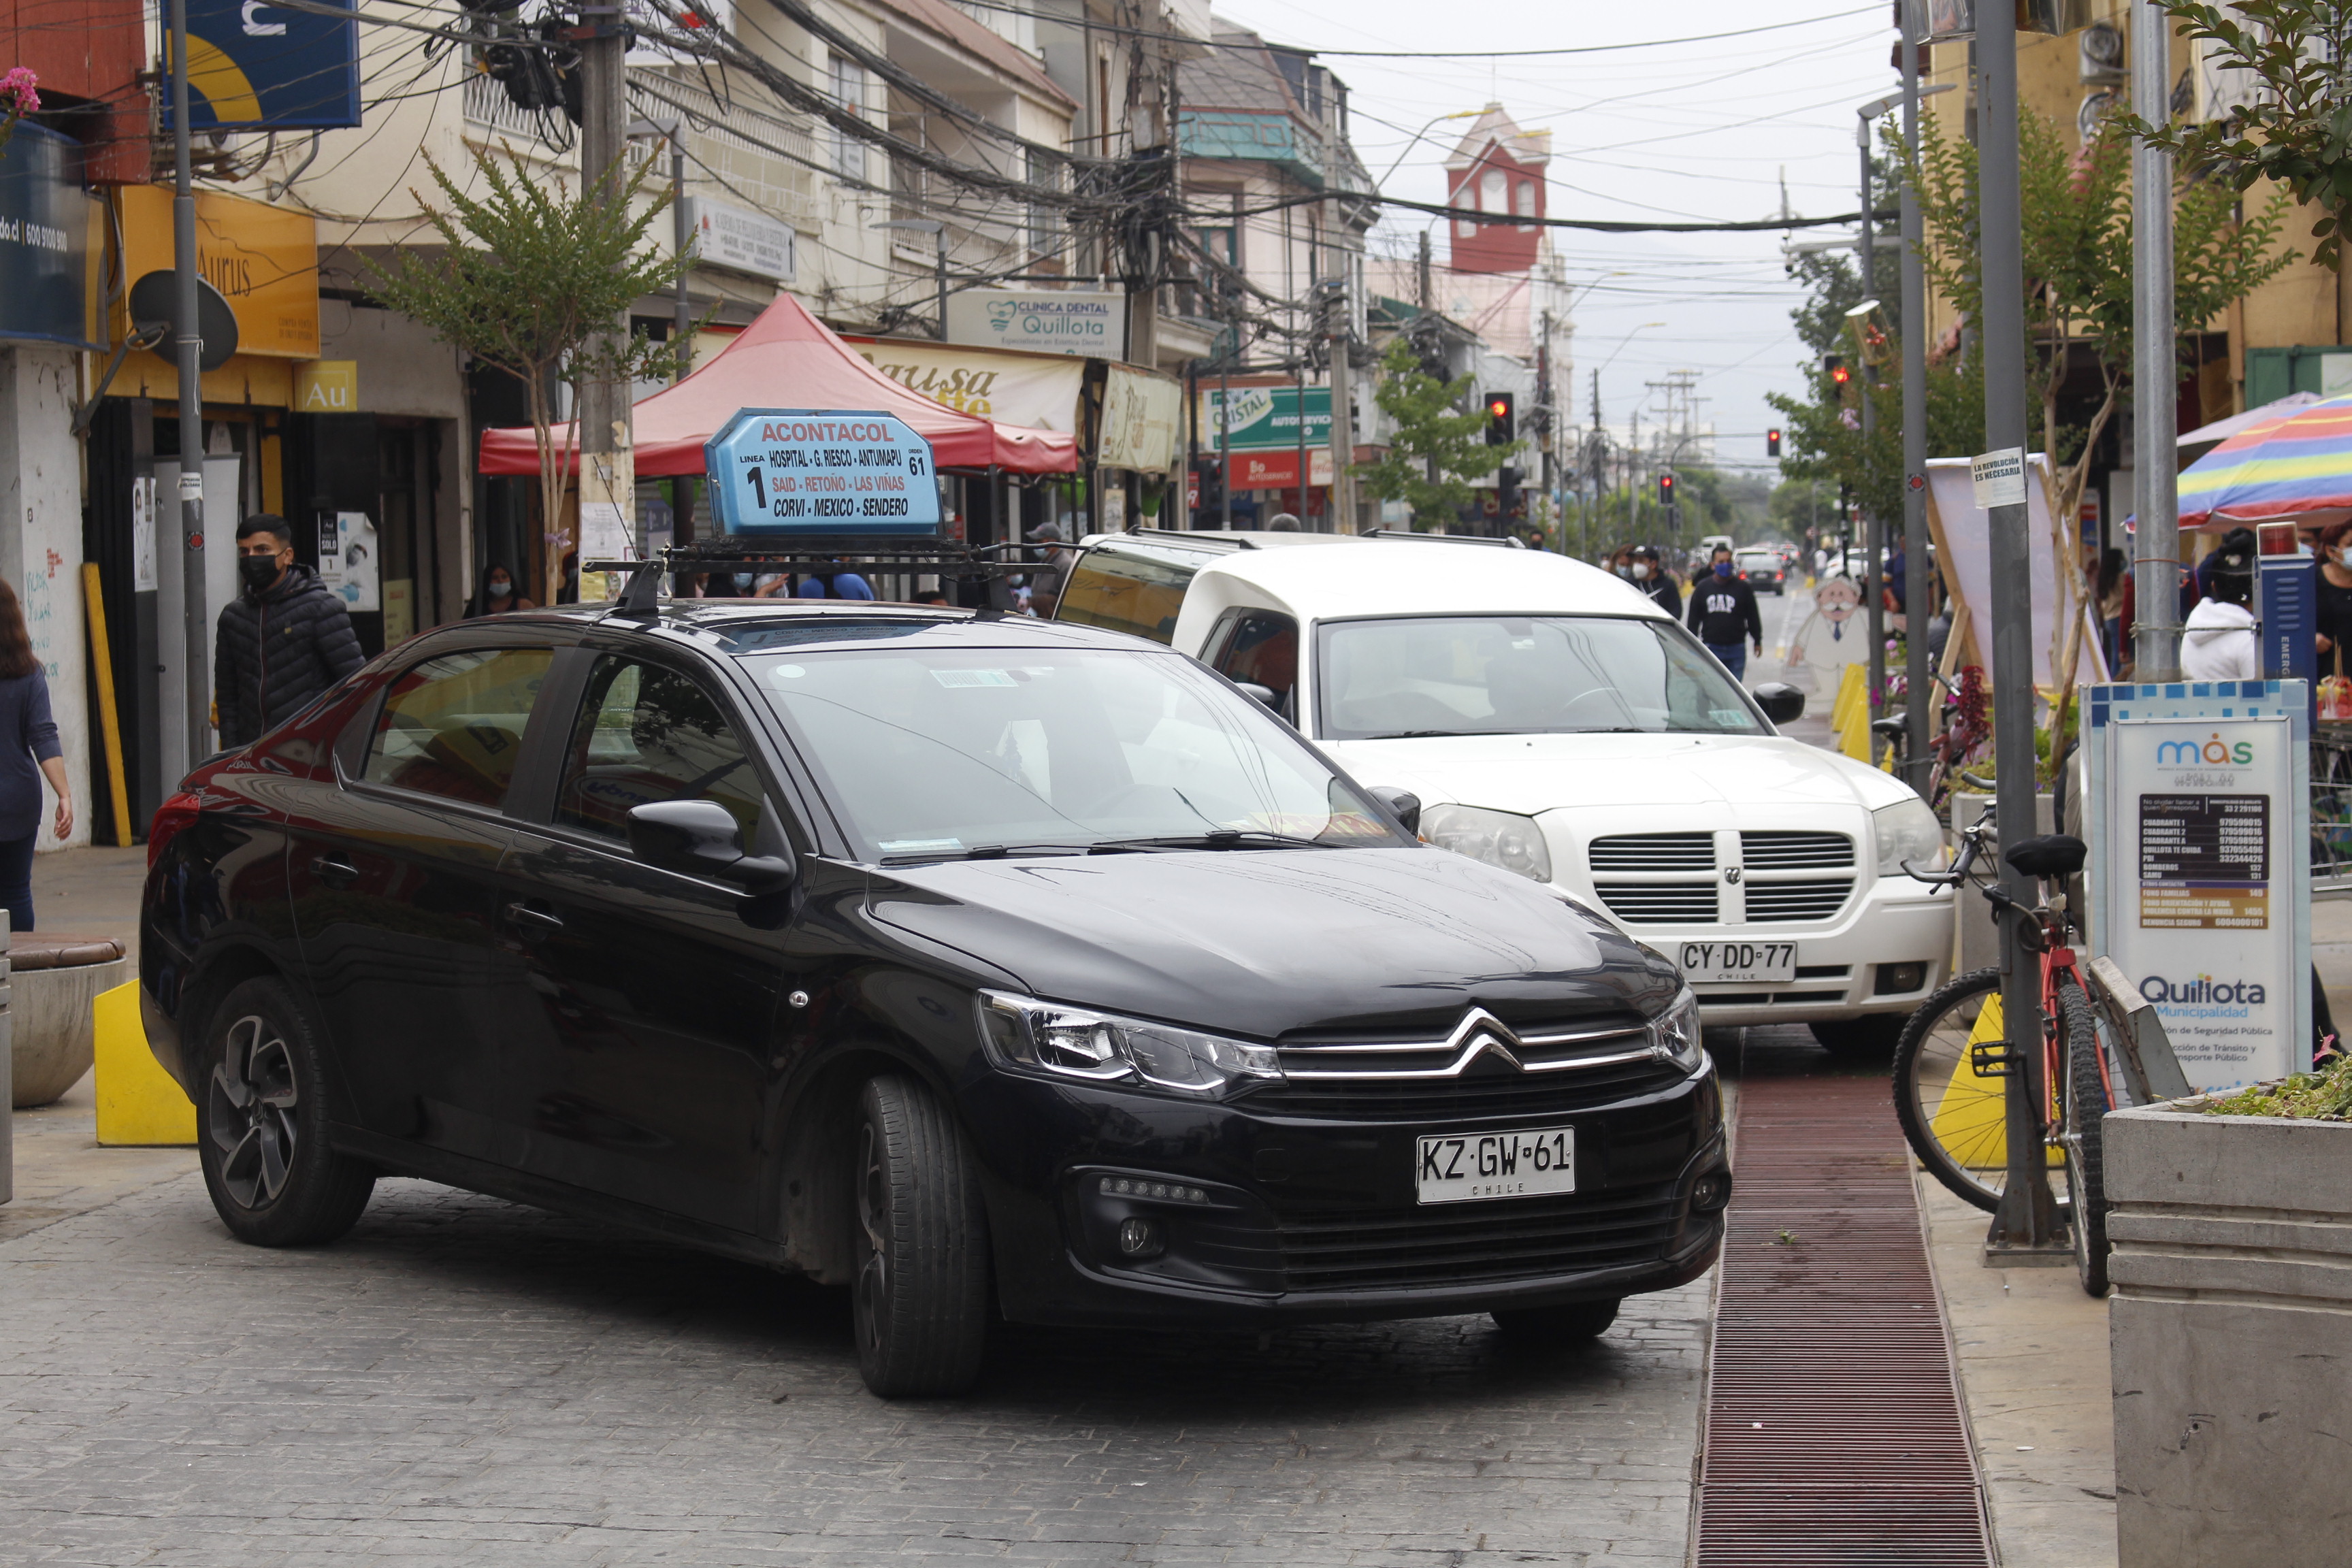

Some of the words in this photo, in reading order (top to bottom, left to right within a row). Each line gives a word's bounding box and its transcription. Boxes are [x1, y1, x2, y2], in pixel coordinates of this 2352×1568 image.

[27, 223, 41, 246] 600
[42, 225, 56, 250] 9100
[57, 229, 67, 252] 900
[198, 243, 250, 297] Aurus
[1018, 301, 1063, 313] CLINICA
[1066, 302, 1109, 313] DENTAL
[1023, 315, 1103, 335] Quillota
[306, 382, 346, 407] Au
[762, 423, 894, 442] ACONTACOL
[740, 455, 765, 463] LINEA
[769, 450, 808, 468] HOSPITAL
[814, 450, 823, 467] G.
[825, 449, 852, 468] RIESCO
[859, 448, 902, 467] ANTUMAPU
[909, 457, 926, 476] 61
[1982, 457, 2019, 470] REVOLUCIÓN
[773, 477, 796, 493] SAID
[806, 472, 846, 492] RETOÑO
[855, 476, 873, 491] LAS
[875, 472, 904, 491] VIÑAS
[1975, 473, 1983, 482] ES
[1984, 466, 2021, 480] NECESARIA
[747, 466, 767, 509] 1
[774, 498, 805, 517] CORVI
[814, 498, 853, 517] MEXICO
[863, 497, 909, 517] SENDERO
[321, 540, 337, 551] SOLO
[1705, 593, 1735, 613] GAP
[2140, 973, 2266, 1004] Quillota
[2156, 1006, 2249, 1019] Municipalidad
[2194, 1027, 2238, 1036] Seguridad
[2241, 1027, 2273, 1035] Pública
[2214, 1044, 2248, 1052] Tránsito
[1471, 1182, 1524, 1196] CHILE
